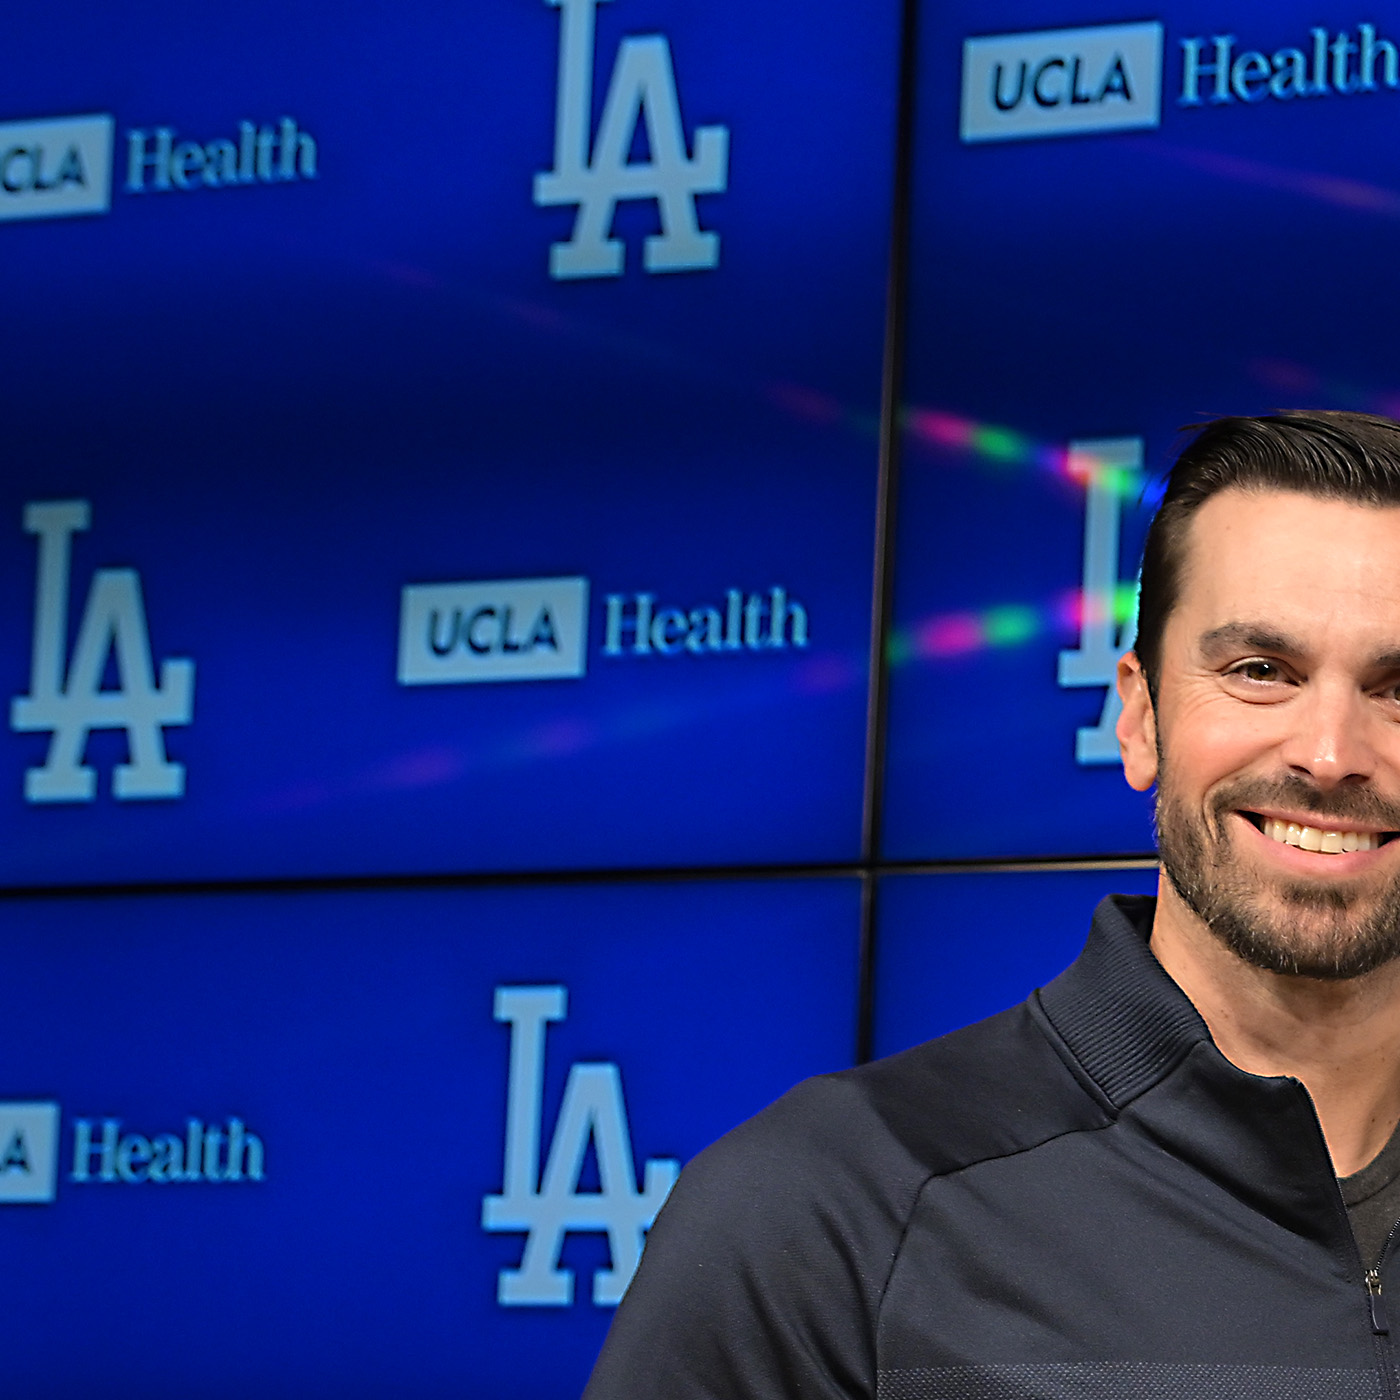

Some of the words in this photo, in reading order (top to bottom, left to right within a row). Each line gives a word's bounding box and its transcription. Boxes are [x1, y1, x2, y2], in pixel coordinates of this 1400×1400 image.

[1, 146, 88, 194] CLA
[124, 114, 319, 194] Health
[534, 0, 730, 279] LA
[990, 55, 1134, 112] UCLA
[1178, 24, 1400, 106] Health
[11, 502, 195, 803] LA
[429, 605, 560, 656] UCLA
[603, 586, 808, 657] Health
[1058, 438, 1146, 765] L
[70, 1116, 266, 1184] Health
[482, 985, 681, 1306] LA
